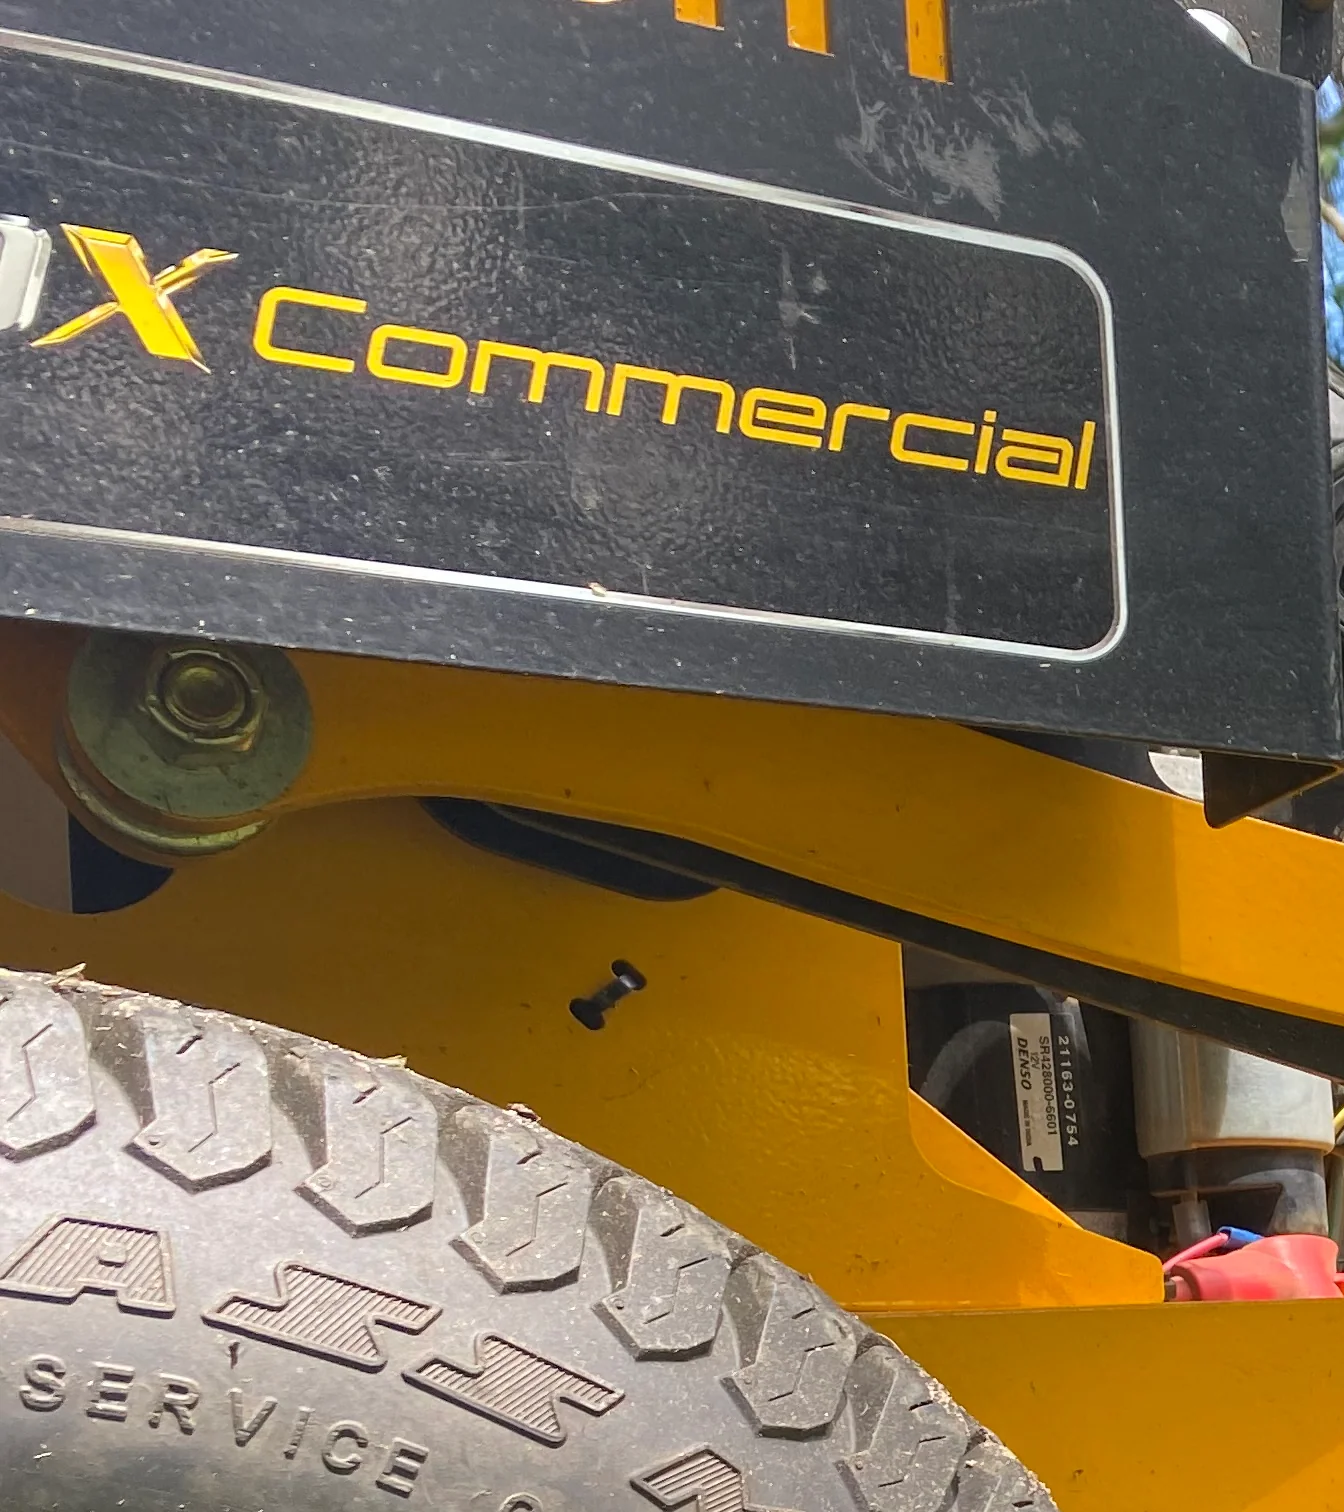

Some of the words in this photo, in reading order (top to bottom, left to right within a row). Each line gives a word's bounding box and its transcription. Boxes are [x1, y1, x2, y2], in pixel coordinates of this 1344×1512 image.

[252, 285, 1096, 491] Commercial
[1017, 1036, 1032, 1091] DENSO
[1030, 1051, 1041, 1070] 12V
[1039, 1035, 1058, 1136] SR428000-6601
[18, 1353, 431, 1499] SERVICE
